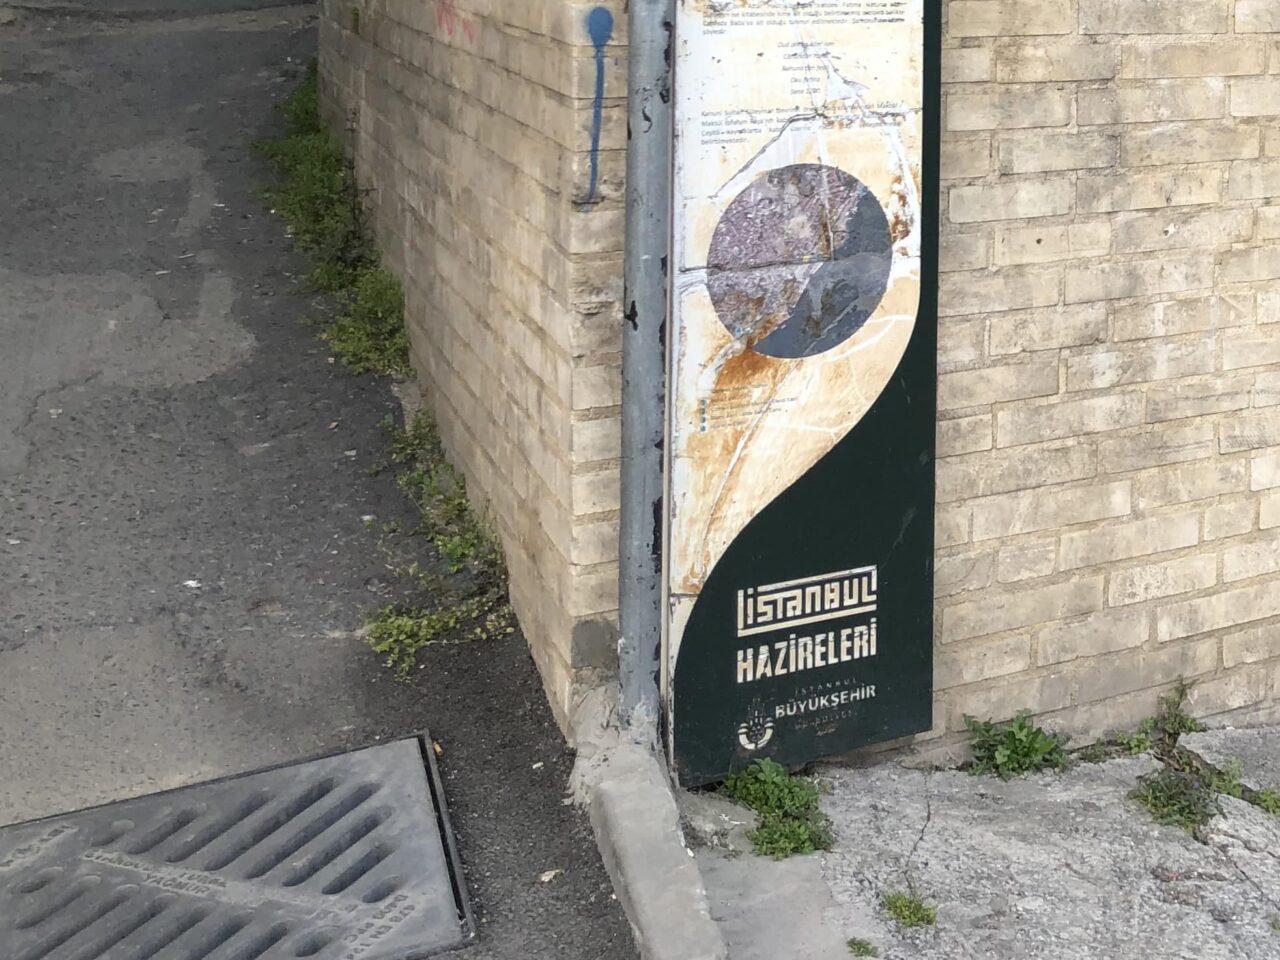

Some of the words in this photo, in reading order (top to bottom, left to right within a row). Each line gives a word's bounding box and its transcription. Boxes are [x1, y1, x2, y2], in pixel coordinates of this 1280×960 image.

[744, 570, 877, 627] İSTANBUL
[737, 617, 877, 683] HAZİRELERİ
[775, 683, 876, 719] BÜYÜKŞEHİR
